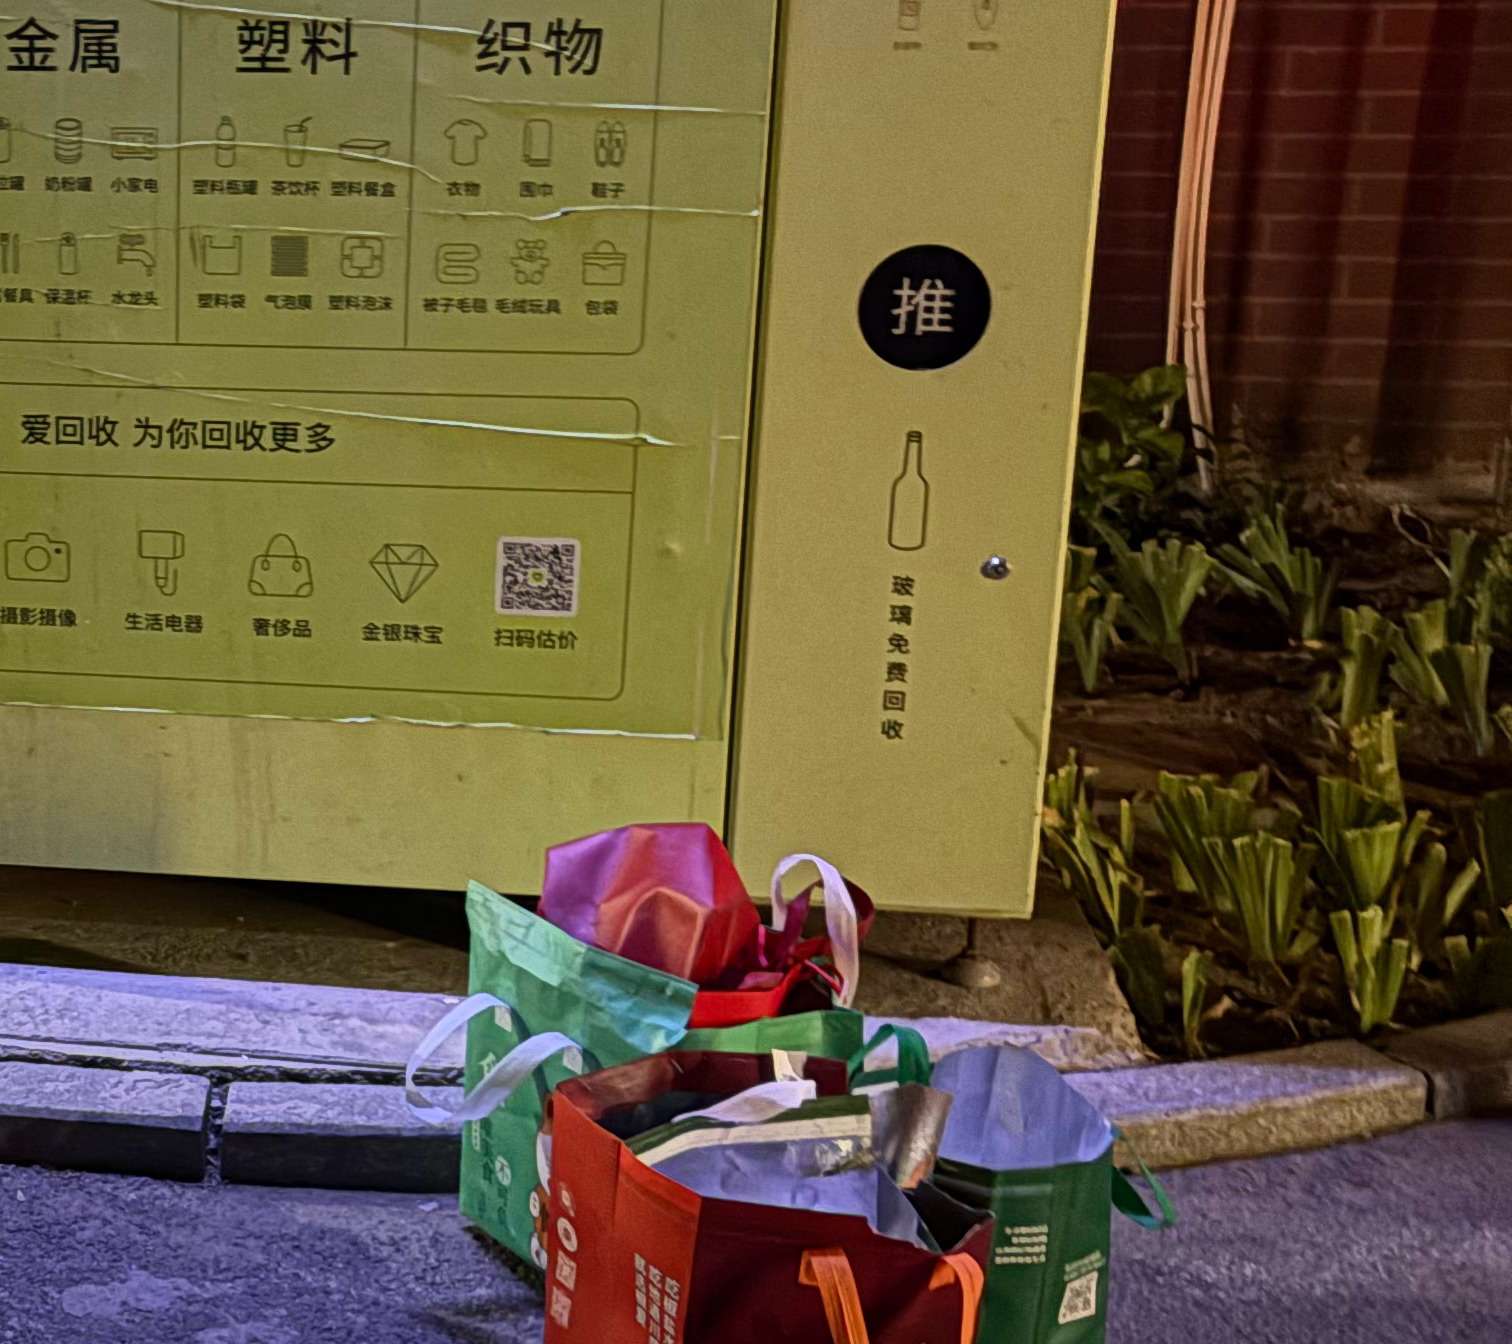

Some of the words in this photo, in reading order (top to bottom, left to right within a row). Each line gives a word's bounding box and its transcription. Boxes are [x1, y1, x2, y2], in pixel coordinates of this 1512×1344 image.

[4, 14, 121, 75] 金属
[235, 17, 359, 76] 塑料
[474, 16, 604, 76] 织物
[890, 276, 956, 336] 推
[20, 413, 120, 449] 爱回收
[132, 416, 337, 453] 为你回收更多
[124, 612, 204, 634] 生活电器
[252, 617, 313, 640] 奢侈品
[360, 621, 444, 645] 金银珠宝
[493, 628, 579, 651] 扫码估价
[880, 574, 916, 741] 玻璃免费回收
